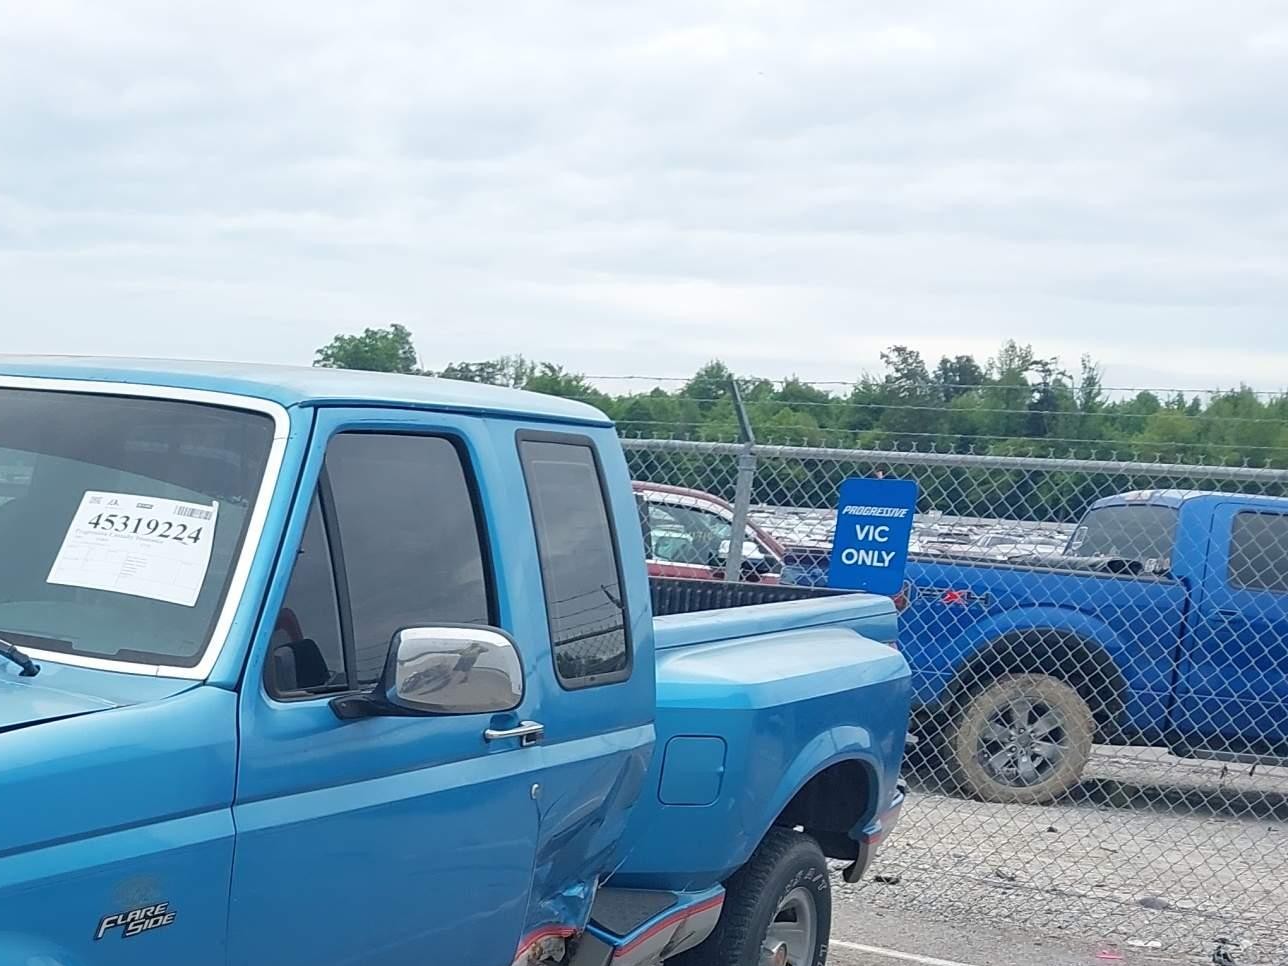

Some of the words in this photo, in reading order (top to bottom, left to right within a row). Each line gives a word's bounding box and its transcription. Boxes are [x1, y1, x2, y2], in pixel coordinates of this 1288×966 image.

[842, 505, 909, 518] PROGRESSIVE
[88, 513, 202, 543] 45319224
[855, 524, 890, 542] VIC
[841, 548, 896, 567] ONLY
[97, 902, 169, 938] FLARE
[125, 912, 176, 936] SIDE
